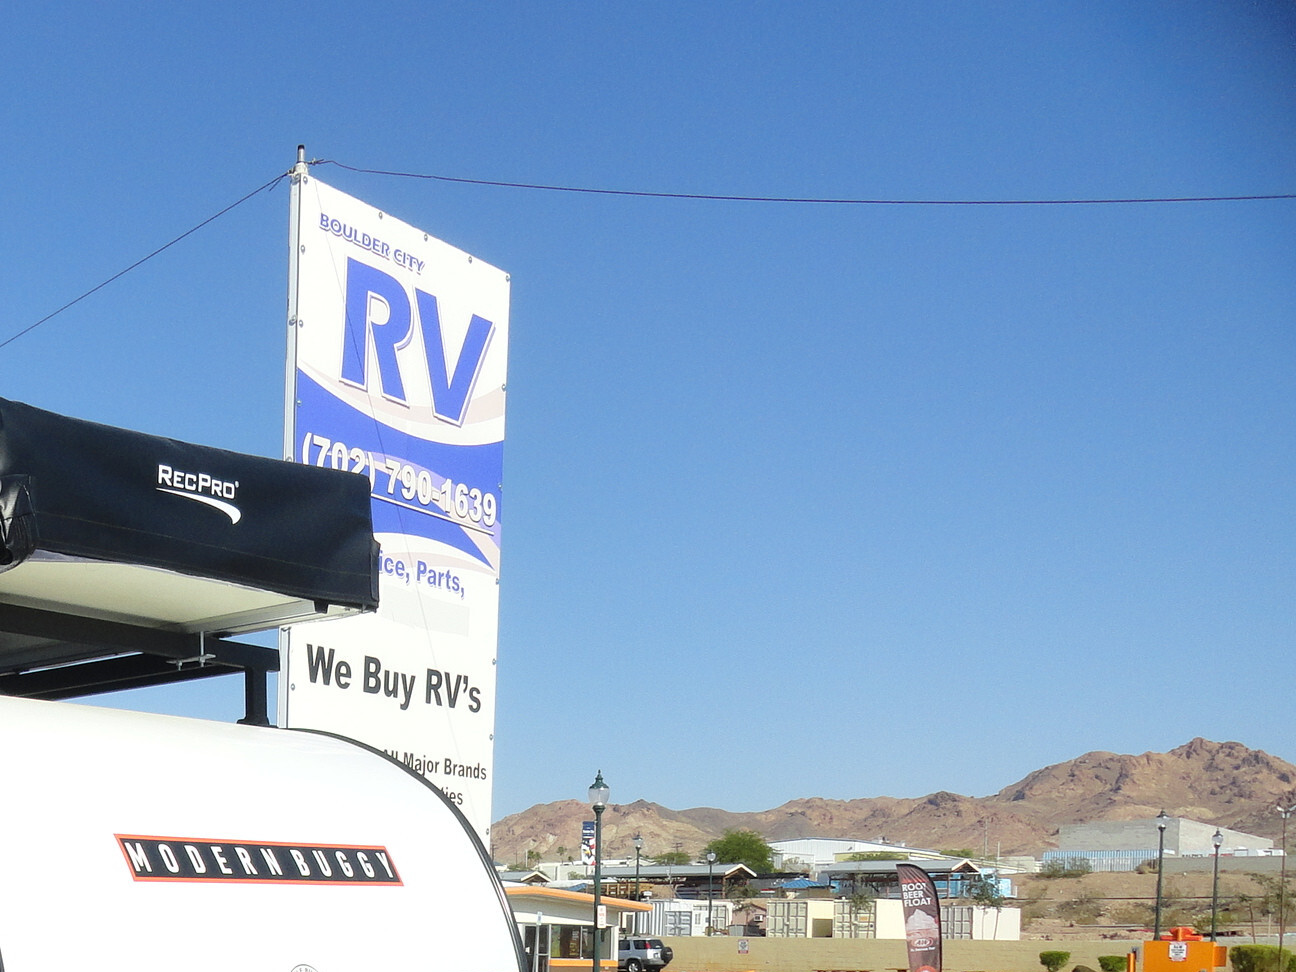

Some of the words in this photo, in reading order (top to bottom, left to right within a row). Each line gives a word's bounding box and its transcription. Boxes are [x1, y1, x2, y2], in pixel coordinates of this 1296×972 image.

[319, 212, 390, 258] BOULDER
[393, 248, 425, 276] CITY
[339, 255, 496, 427] RV
[385, 458, 497, 527] 790-1639
[416, 560, 465, 598] Parts,
[306, 643, 352, 690] We
[363, 655, 416, 710] Buy
[425, 668, 481, 713] RV's
[404, 752, 440, 777] Major
[444, 758, 487, 780] Brands
[124, 841, 283, 876] MODERN
[290, 849, 395, 879] BUGGY
[903, 891, 924, 899] BEER
[904, 898, 931, 907] FLOAT
